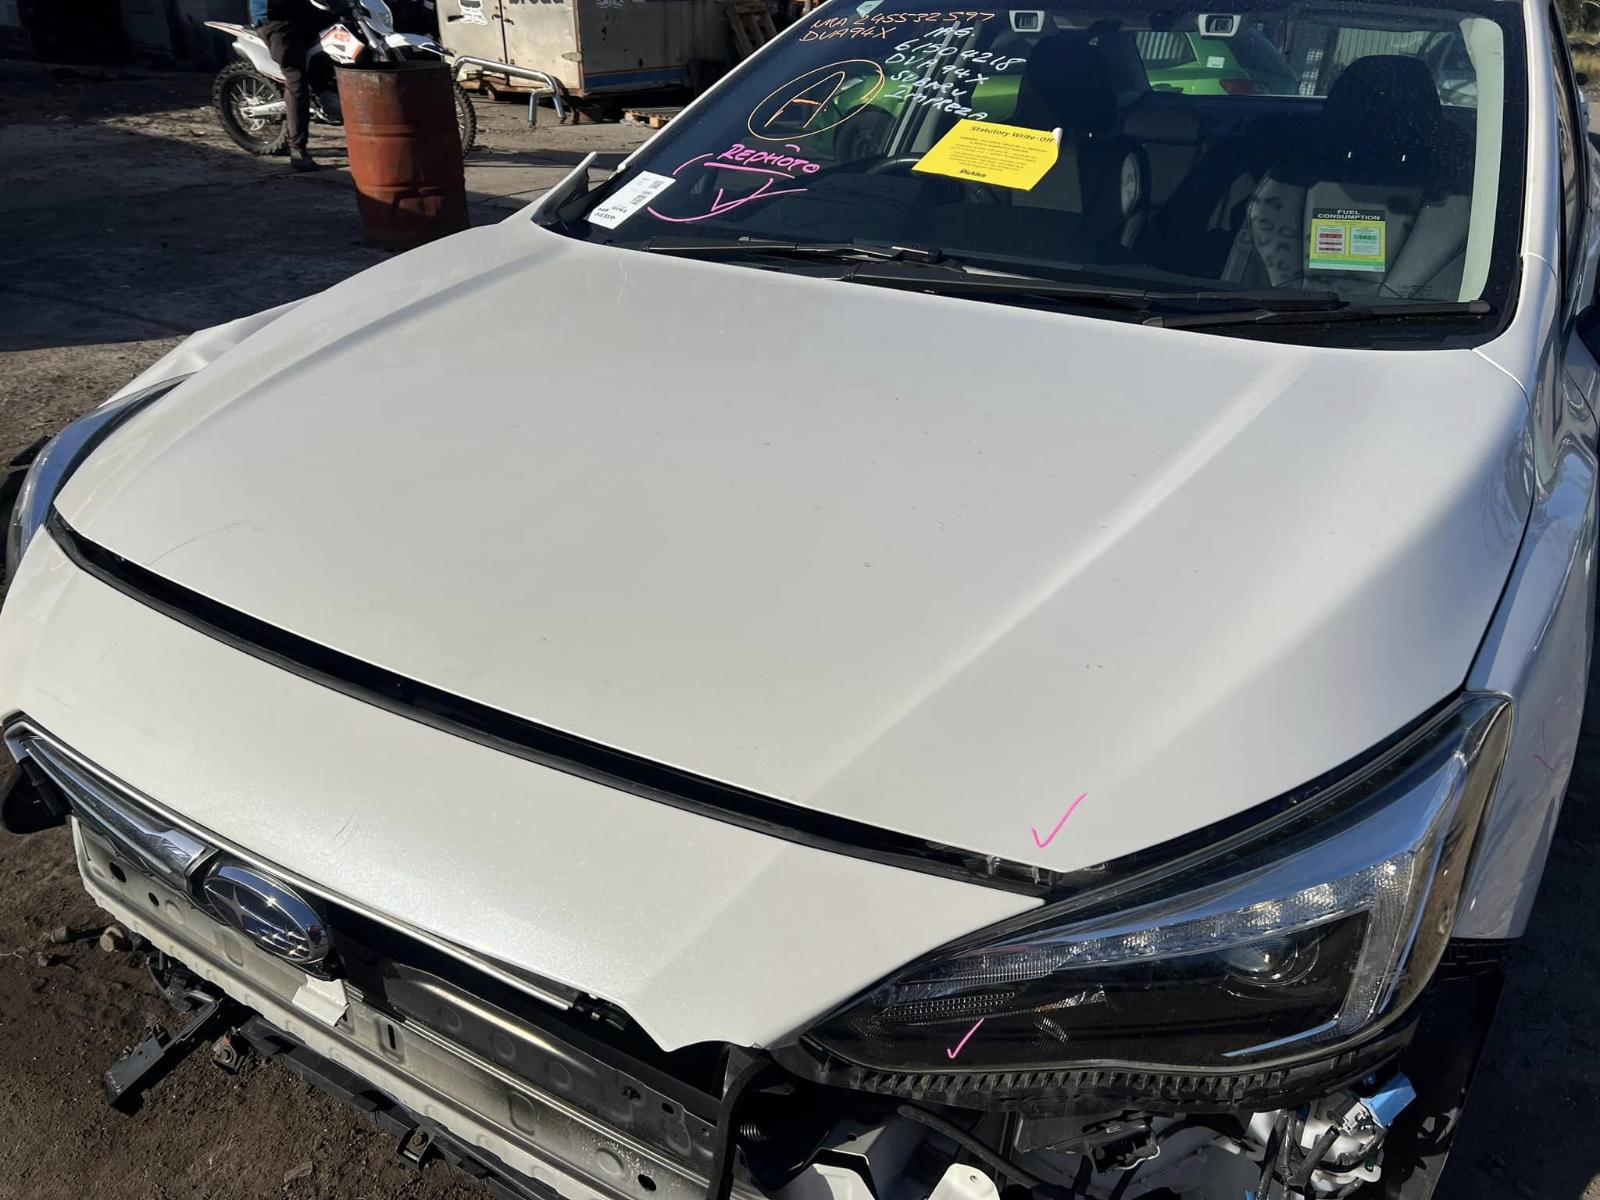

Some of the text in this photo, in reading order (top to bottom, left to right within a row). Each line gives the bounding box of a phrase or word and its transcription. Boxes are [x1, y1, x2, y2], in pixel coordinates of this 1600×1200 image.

[969, 124, 1011, 138] Statutory
[1012, 131, 1055, 144] Write-Off
[959, 168, 987, 179] Pickles
